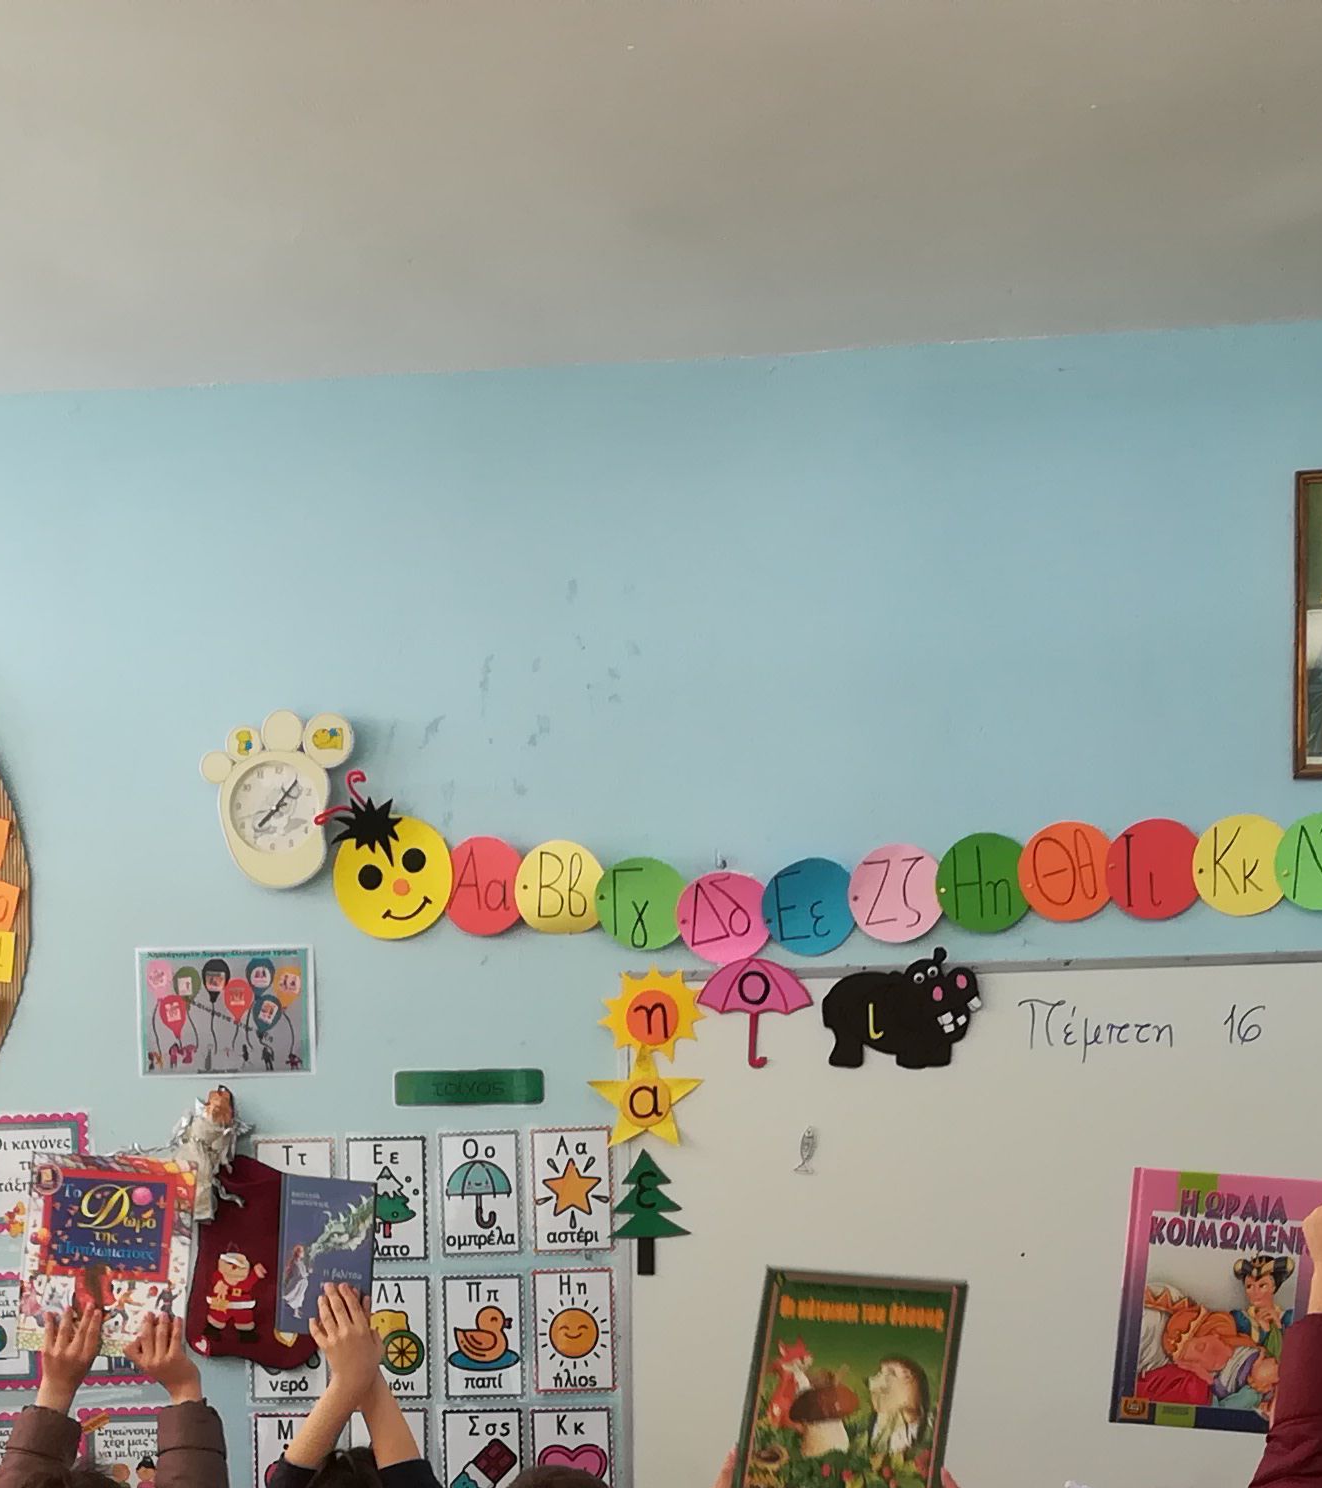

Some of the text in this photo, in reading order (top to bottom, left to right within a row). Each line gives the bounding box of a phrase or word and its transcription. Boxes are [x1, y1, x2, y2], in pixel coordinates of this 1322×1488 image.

[1019, 1000, 1174, 1062] Πέμπτη
[1224, 1004, 1266, 1048] 16
[13, 1136, 70, 1150] κανόνες
[1180, 1189, 1287, 1224] Η ΩΡΑΙΑ
[446, 1226, 516, 1249] ομπρέλα
[546, 1227, 599, 1245] αστέρι
[375, 1237, 410, 1256] λατο
[270, 1372, 309, 1395] νερό
[464, 1372, 503, 1389] παπί
[553, 1369, 597, 1388] ήλιος
